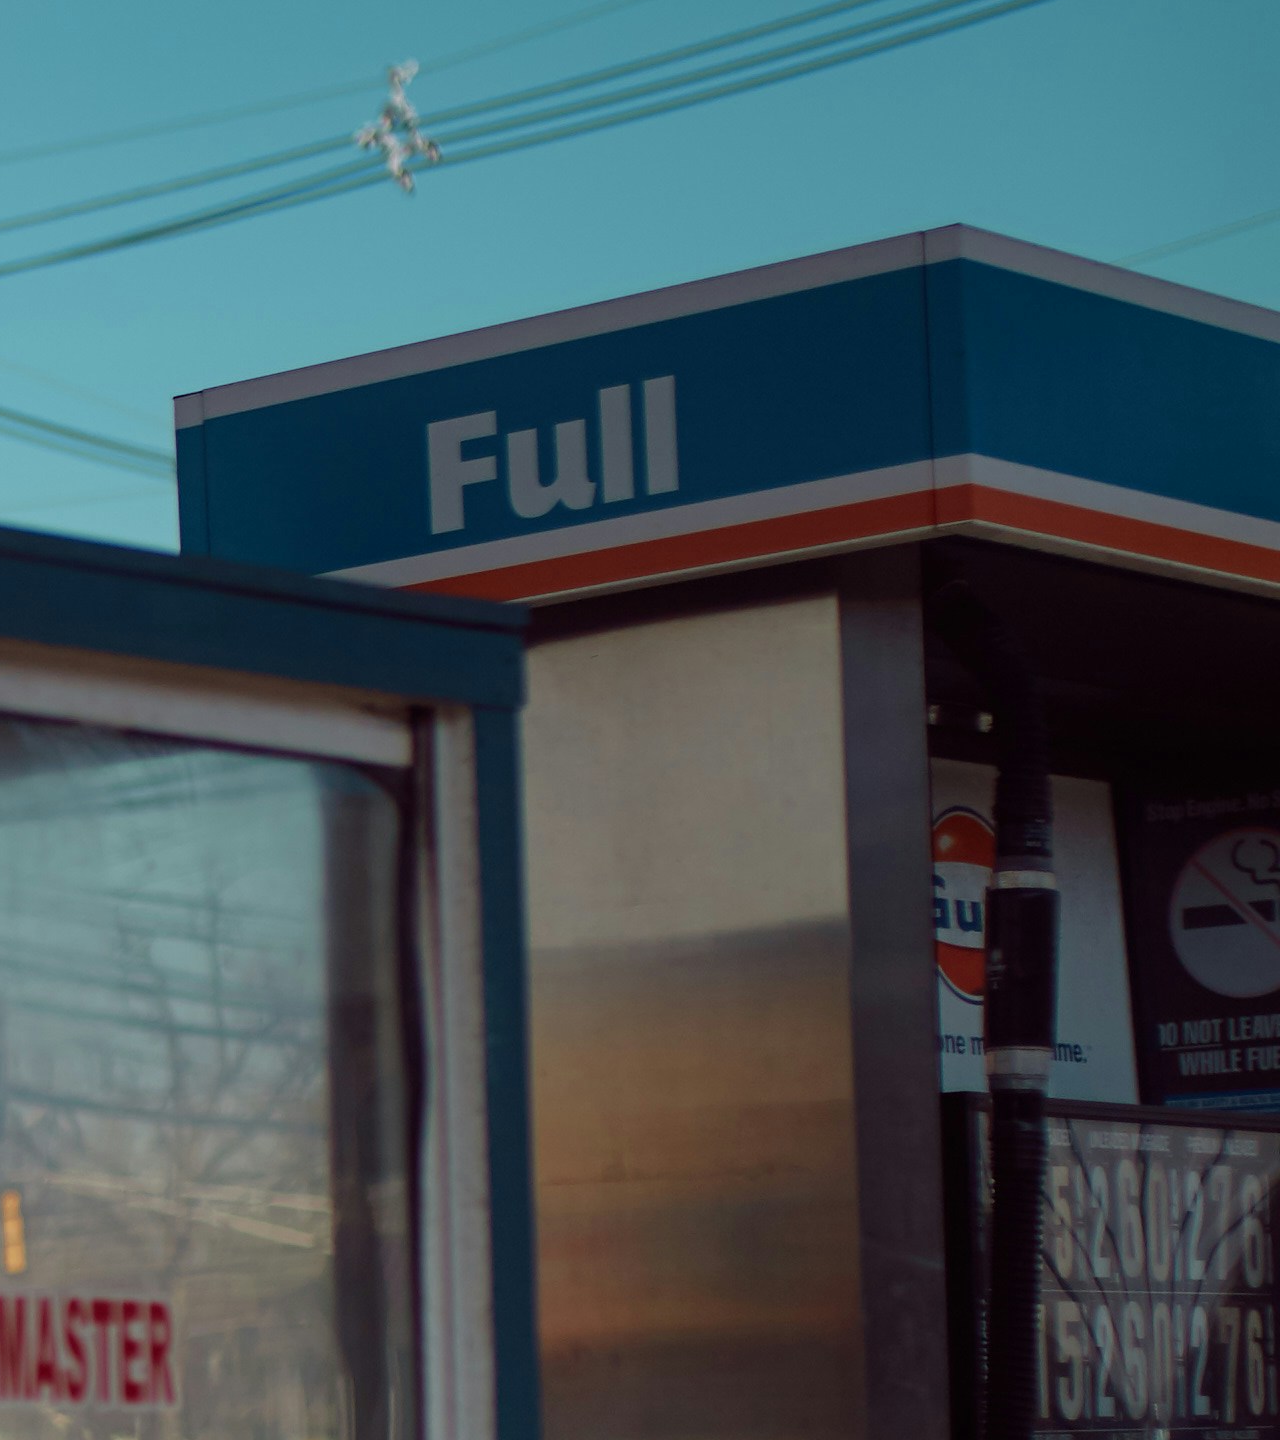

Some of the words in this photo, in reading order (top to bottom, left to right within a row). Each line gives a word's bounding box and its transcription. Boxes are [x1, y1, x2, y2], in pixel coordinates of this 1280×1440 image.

[427, 374, 679, 535] Full
[1182, 1018, 1223, 1045] NOT
[1179, 1049, 1243, 1077] WHILE
